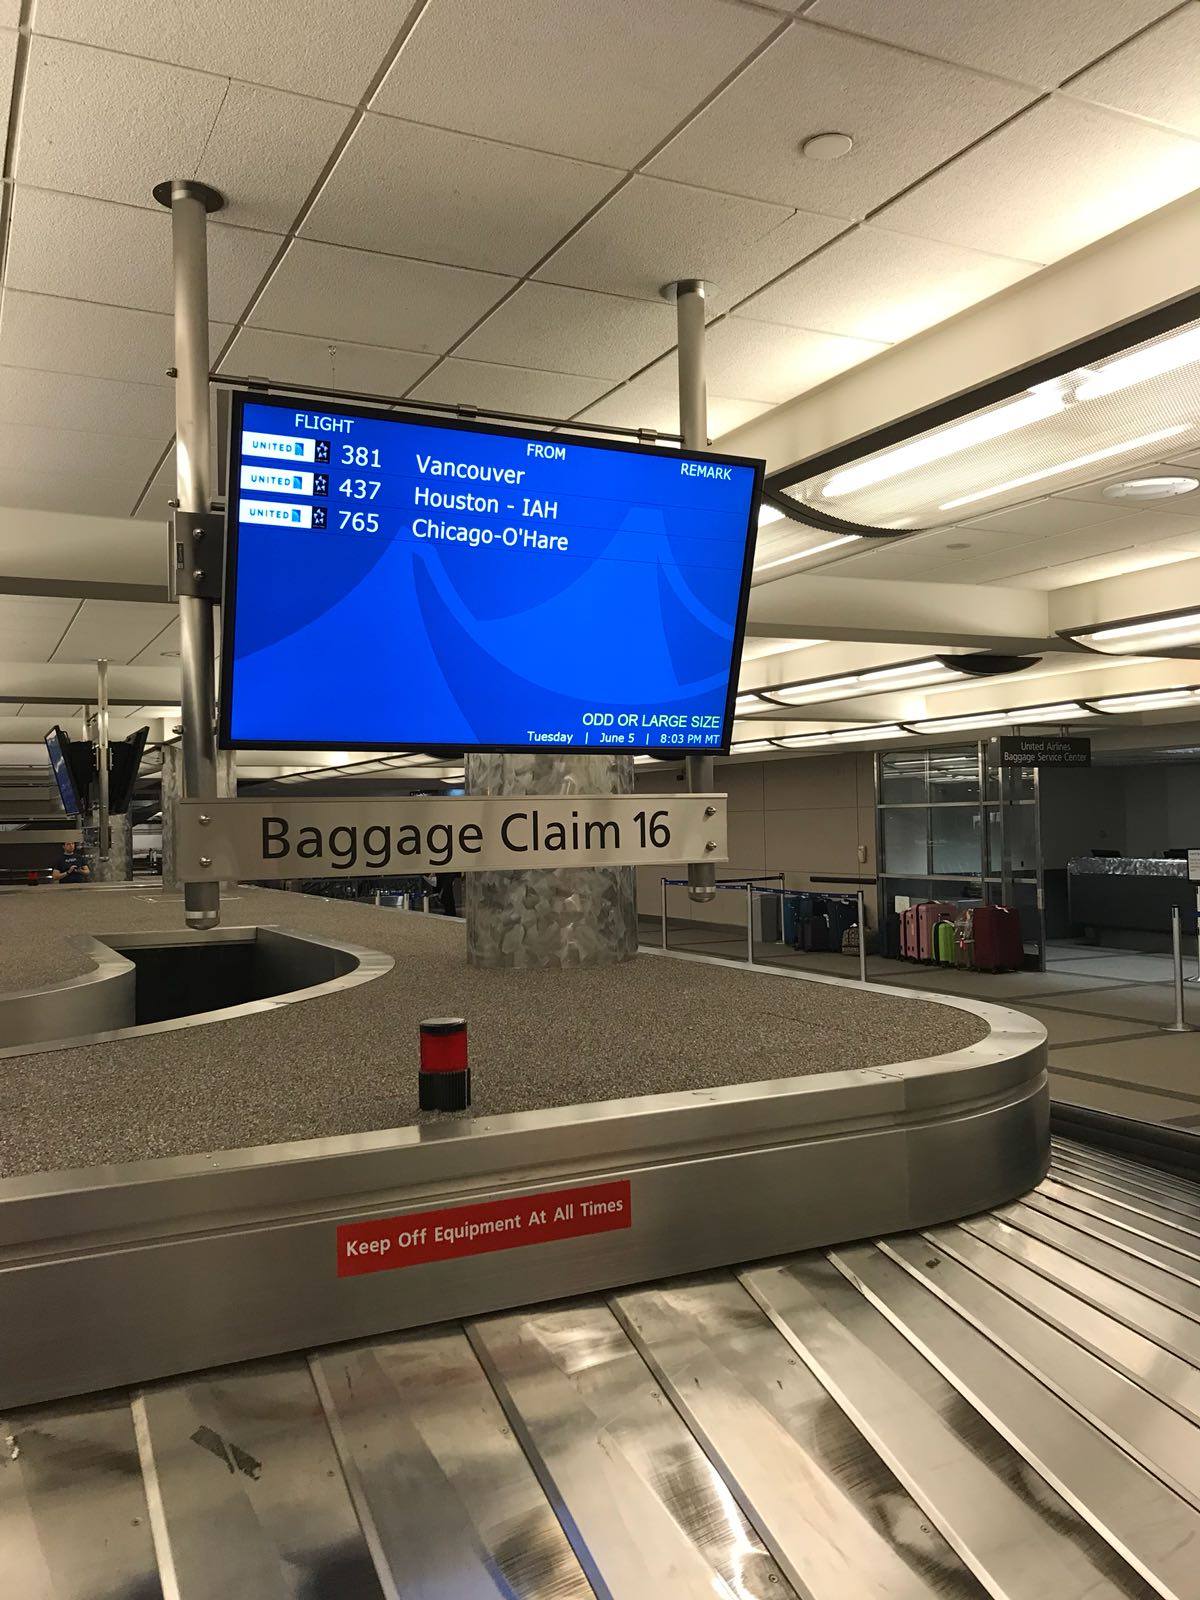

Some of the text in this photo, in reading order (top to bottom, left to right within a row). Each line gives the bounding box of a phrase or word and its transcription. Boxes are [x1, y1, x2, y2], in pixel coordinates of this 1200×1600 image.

[295, 414, 354, 433] FLIGHT
[252, 440, 292, 452] UNITED
[527, 443, 566, 460] FROM
[341, 445, 381, 468] 381
[416, 454, 526, 485] Vancouver
[680, 462, 732, 480] REMARK
[251, 475, 291, 486] UNITED
[338, 479, 381, 500] 437
[414, 487, 499, 513] Houston
[522, 498, 558, 519] IAH
[249, 508, 289, 519] UNITED
[338, 510, 379, 533] 765
[412, 519, 569, 551] Chicago-O'Hare
[582, 713, 720, 729] ODD OR LARGE SIZE
[527, 731, 573, 744] Tuesday
[600, 732, 625, 743] June
[628, 733, 635, 743] 5
[660, 733, 684, 744] 8:03
[687, 734, 701, 744] PM
[705, 734, 720, 744] MT
[1021, 742, 1071, 751] United Airlines
[1004, 751, 1087, 763] Baggage Service Center
[261, 810, 671, 869] Baggage Claim 16
[346, 1199, 624, 1257] Keep Off Equipment At All Times
